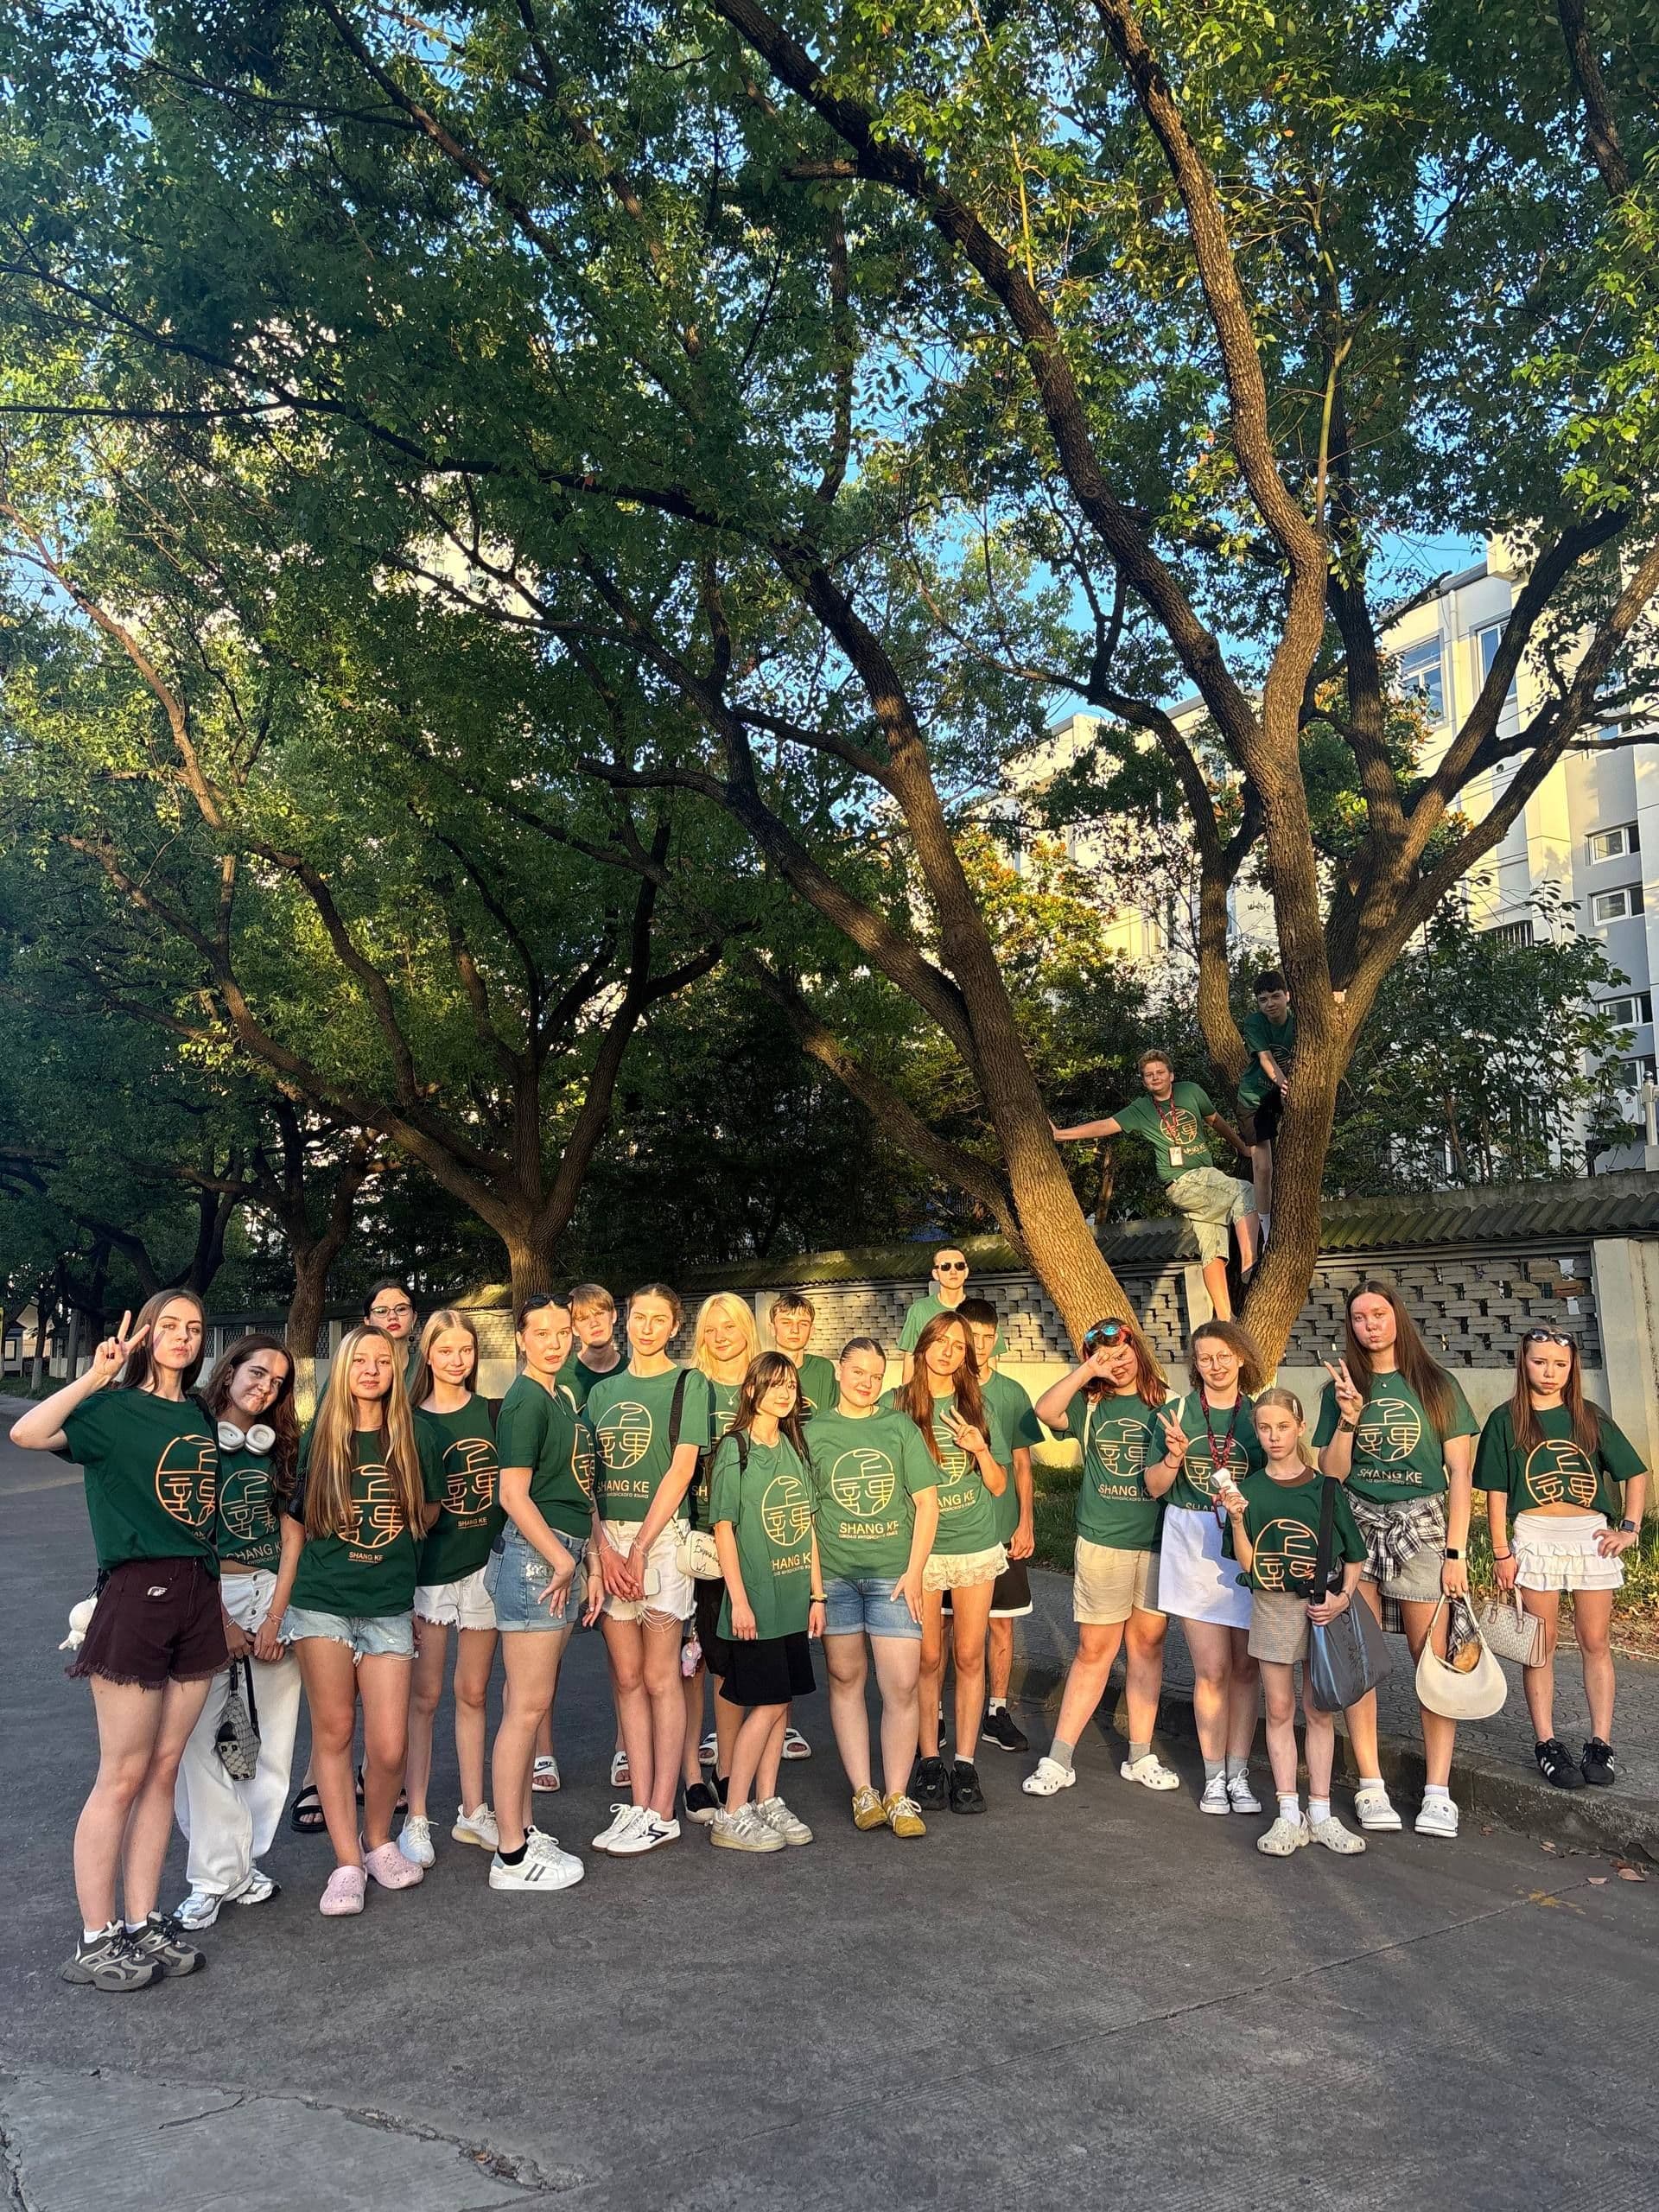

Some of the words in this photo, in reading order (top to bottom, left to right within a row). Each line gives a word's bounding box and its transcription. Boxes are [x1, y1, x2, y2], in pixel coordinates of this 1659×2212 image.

[1357, 1469, 1402, 1480] SHANG
[1406, 1471, 1423, 1484] KE
[633, 1480, 650, 1493] KE
[1098, 1484, 1137, 1497] SHANG
[963, 1489, 975, 1503] KE
[839, 1522, 884, 1535] SHANG
[349, 1551, 373, 1560] SHANG
[771, 1554, 800, 1570] HANG
[802, 1552, 811, 1564] K
